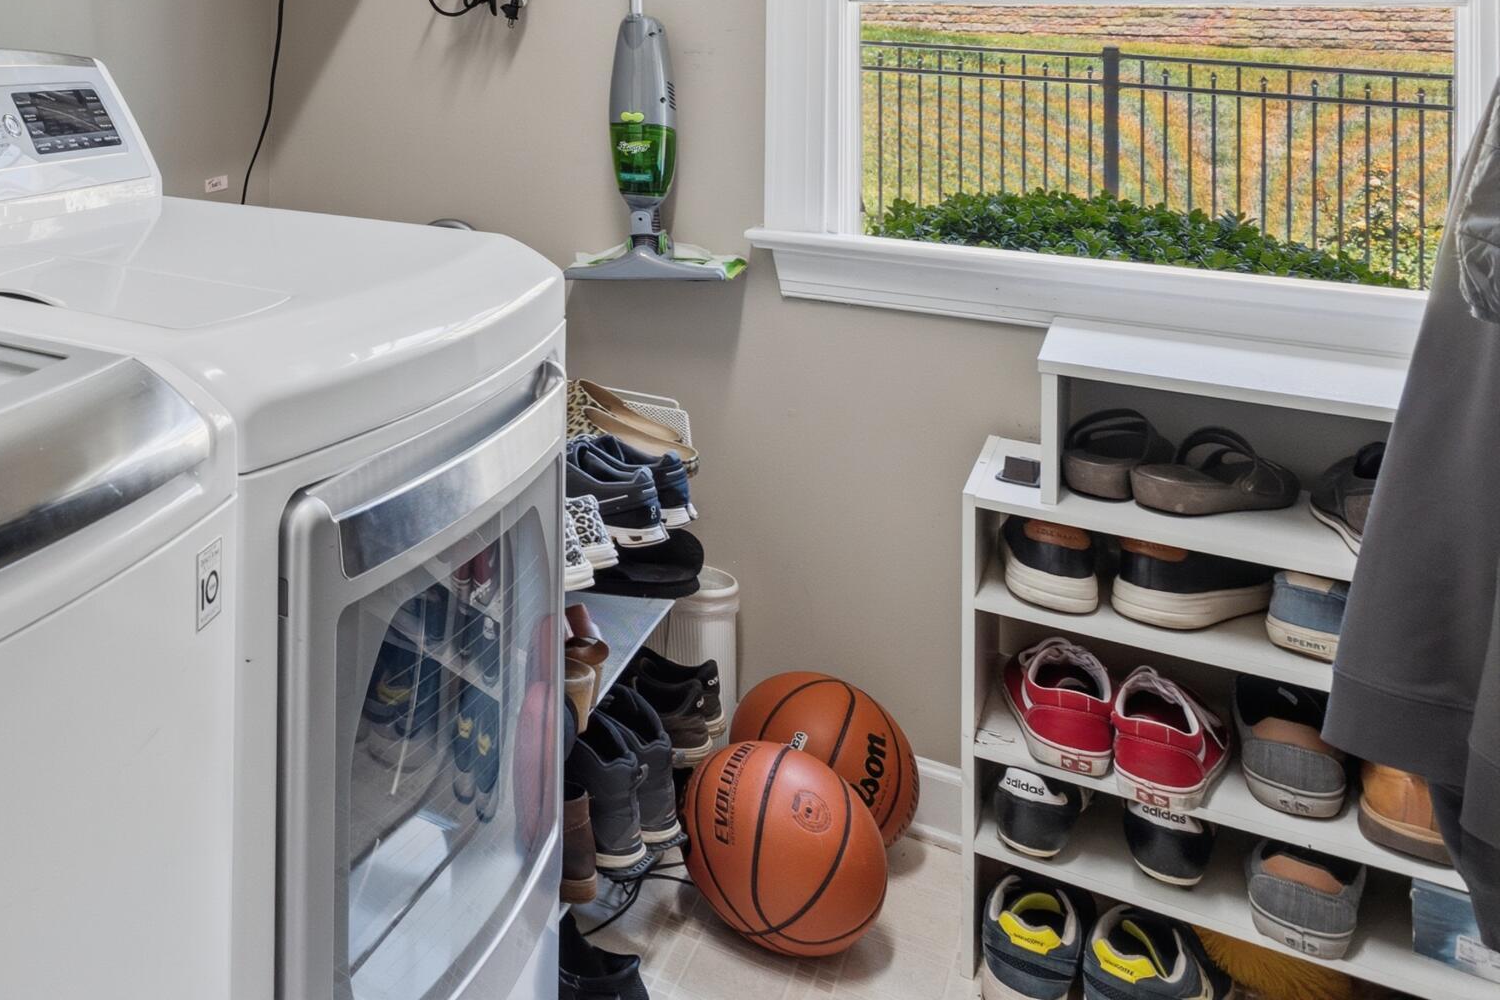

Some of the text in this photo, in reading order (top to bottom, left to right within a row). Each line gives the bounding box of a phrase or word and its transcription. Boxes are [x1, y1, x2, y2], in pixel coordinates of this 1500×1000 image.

[1286, 635, 1328, 652] SPERRY
[850, 732, 887, 808] lson
[712, 741, 756, 846] EVOLUTION
[1005, 776, 1046, 796] adidas
[1141, 804, 1188, 824] adidas
